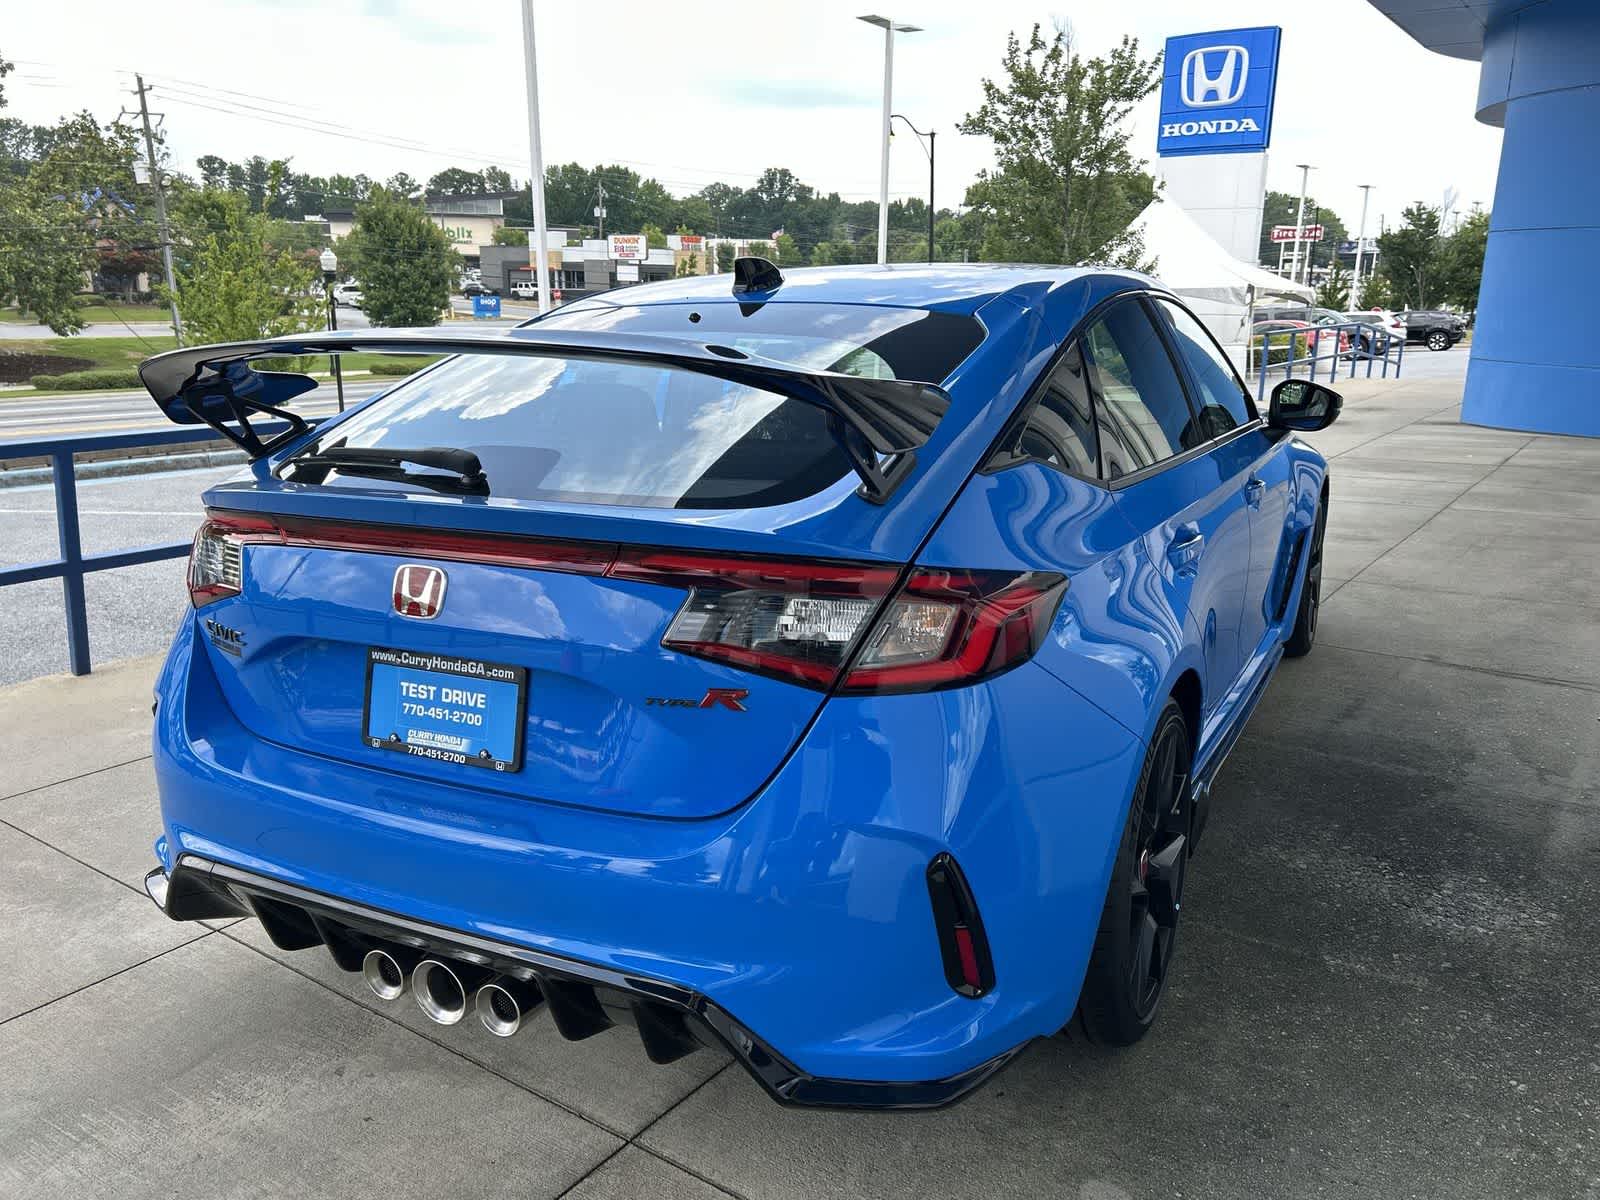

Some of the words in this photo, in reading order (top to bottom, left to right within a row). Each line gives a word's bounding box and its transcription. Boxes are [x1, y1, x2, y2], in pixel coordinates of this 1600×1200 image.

[1161, 118, 1261, 138] HONDA
[371, 650, 515, 680] www.CurryHondaGA.com
[400, 681, 437, 701] TEST
[441, 687, 487, 709] DRIVE
[698, 687, 749, 712] R
[402, 702, 483, 727] 770-451-2700
[407, 729, 434, 740] CURRY
[407, 745, 466, 764] 770-451-2700
